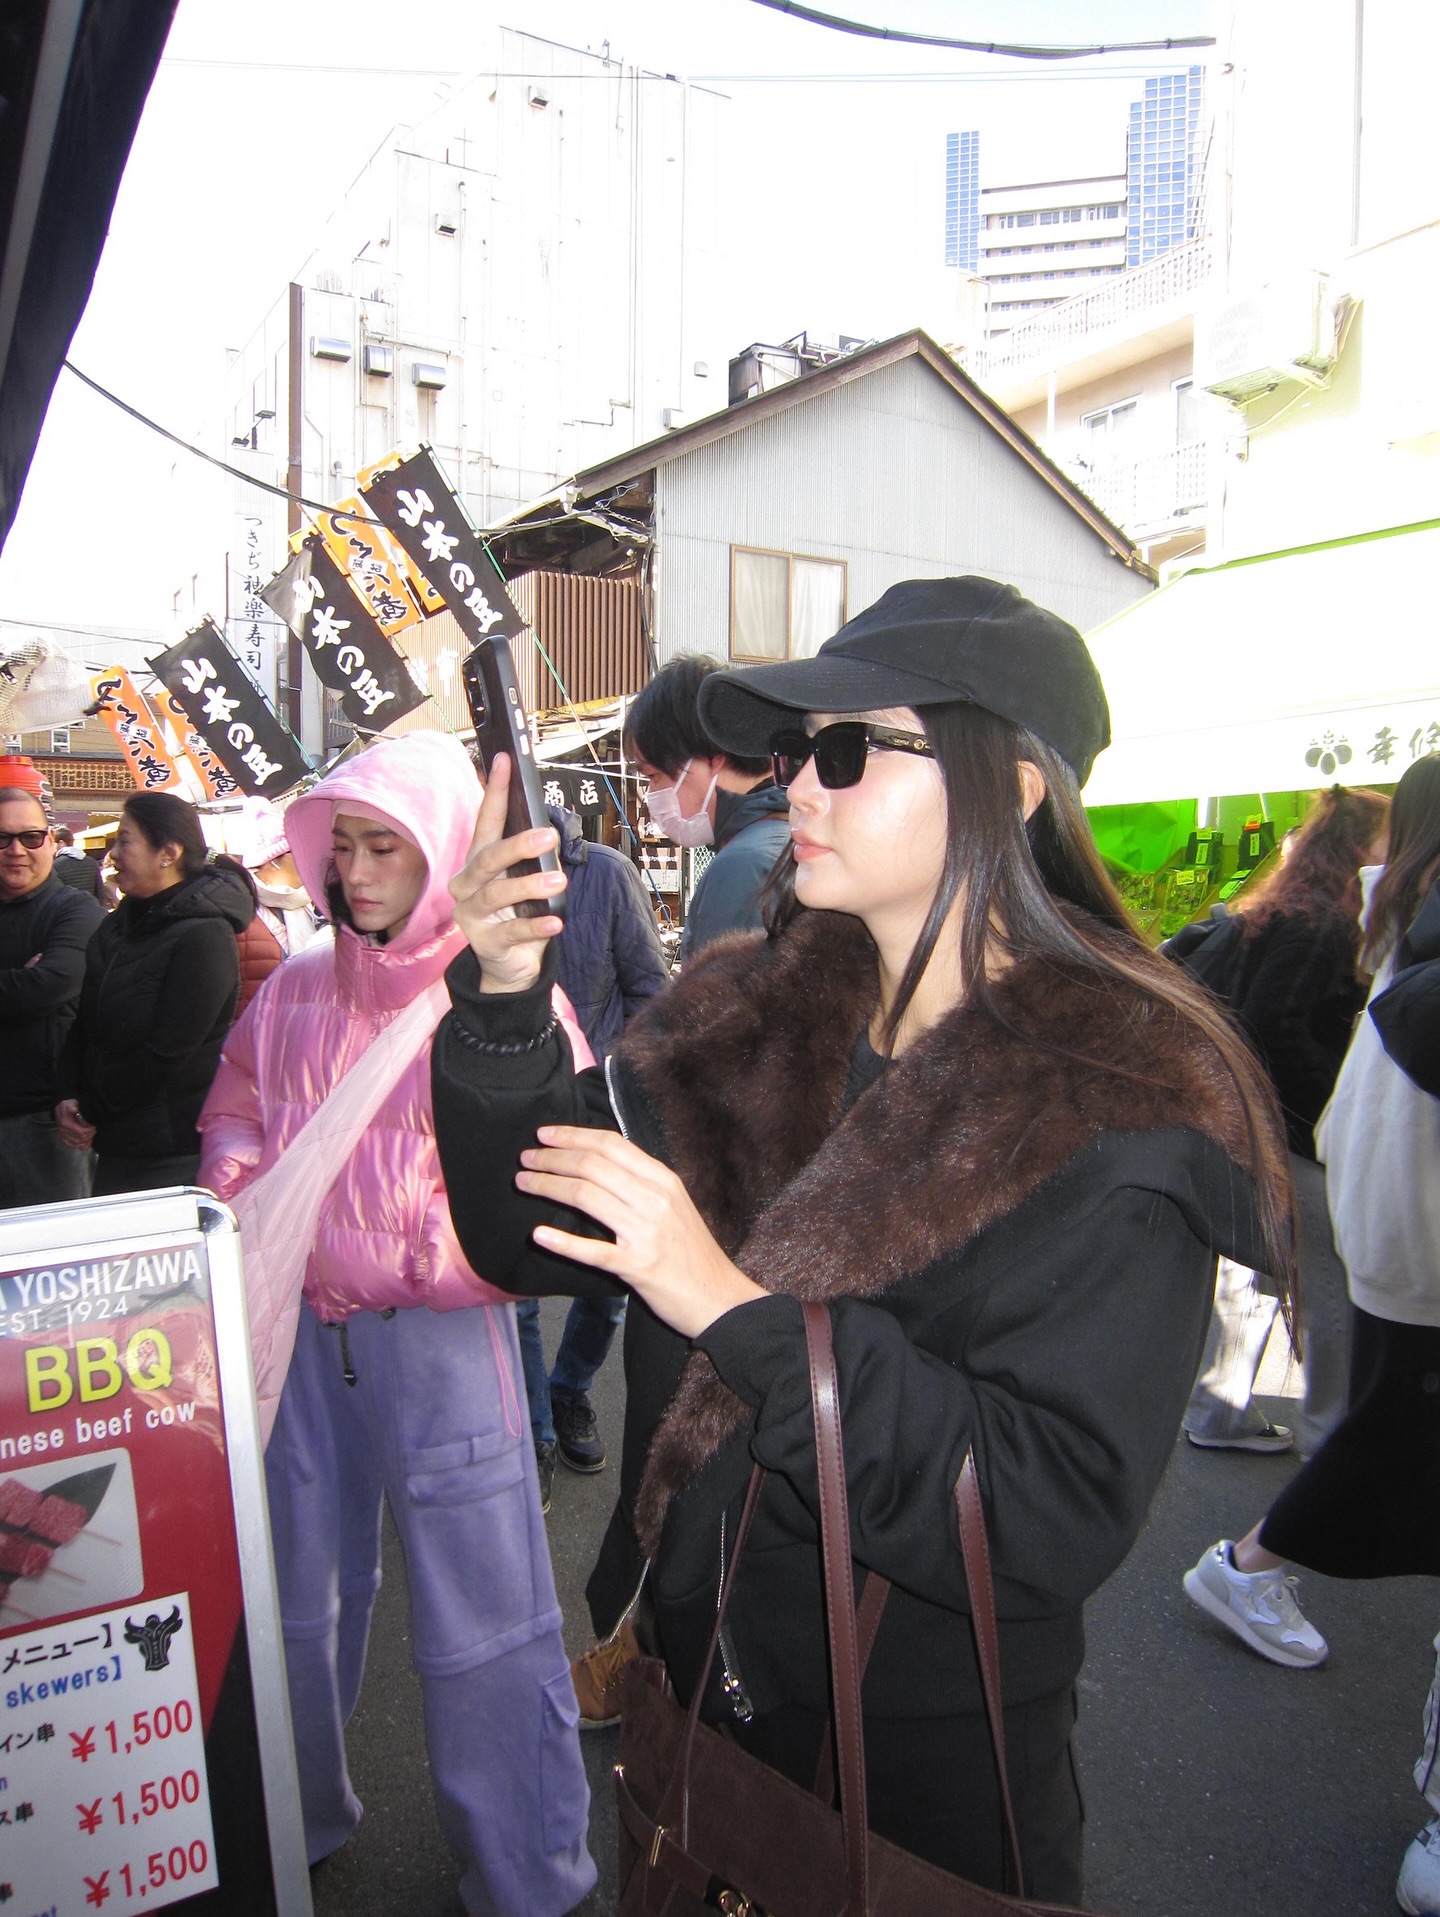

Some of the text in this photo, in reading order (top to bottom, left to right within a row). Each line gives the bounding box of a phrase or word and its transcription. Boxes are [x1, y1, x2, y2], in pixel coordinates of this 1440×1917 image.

[397, 488, 503, 633] 山本の豆
[181, 657, 283, 785] 山本の豆
[543, 779, 599, 806] 商店
[13, 1250, 202, 1308] YOSHIZAWA
[66, 1296, 129, 1325] 1924
[25, 1328, 173, 1413] BBQ
[75, 1407, 133, 1444] beef
[145, 1401, 196, 1430] cow
[69, 1700, 193, 1763] ¥1,500
[76, 1770, 200, 1835] ¥1,500
[83, 1840, 208, 1908] ¥1,500
